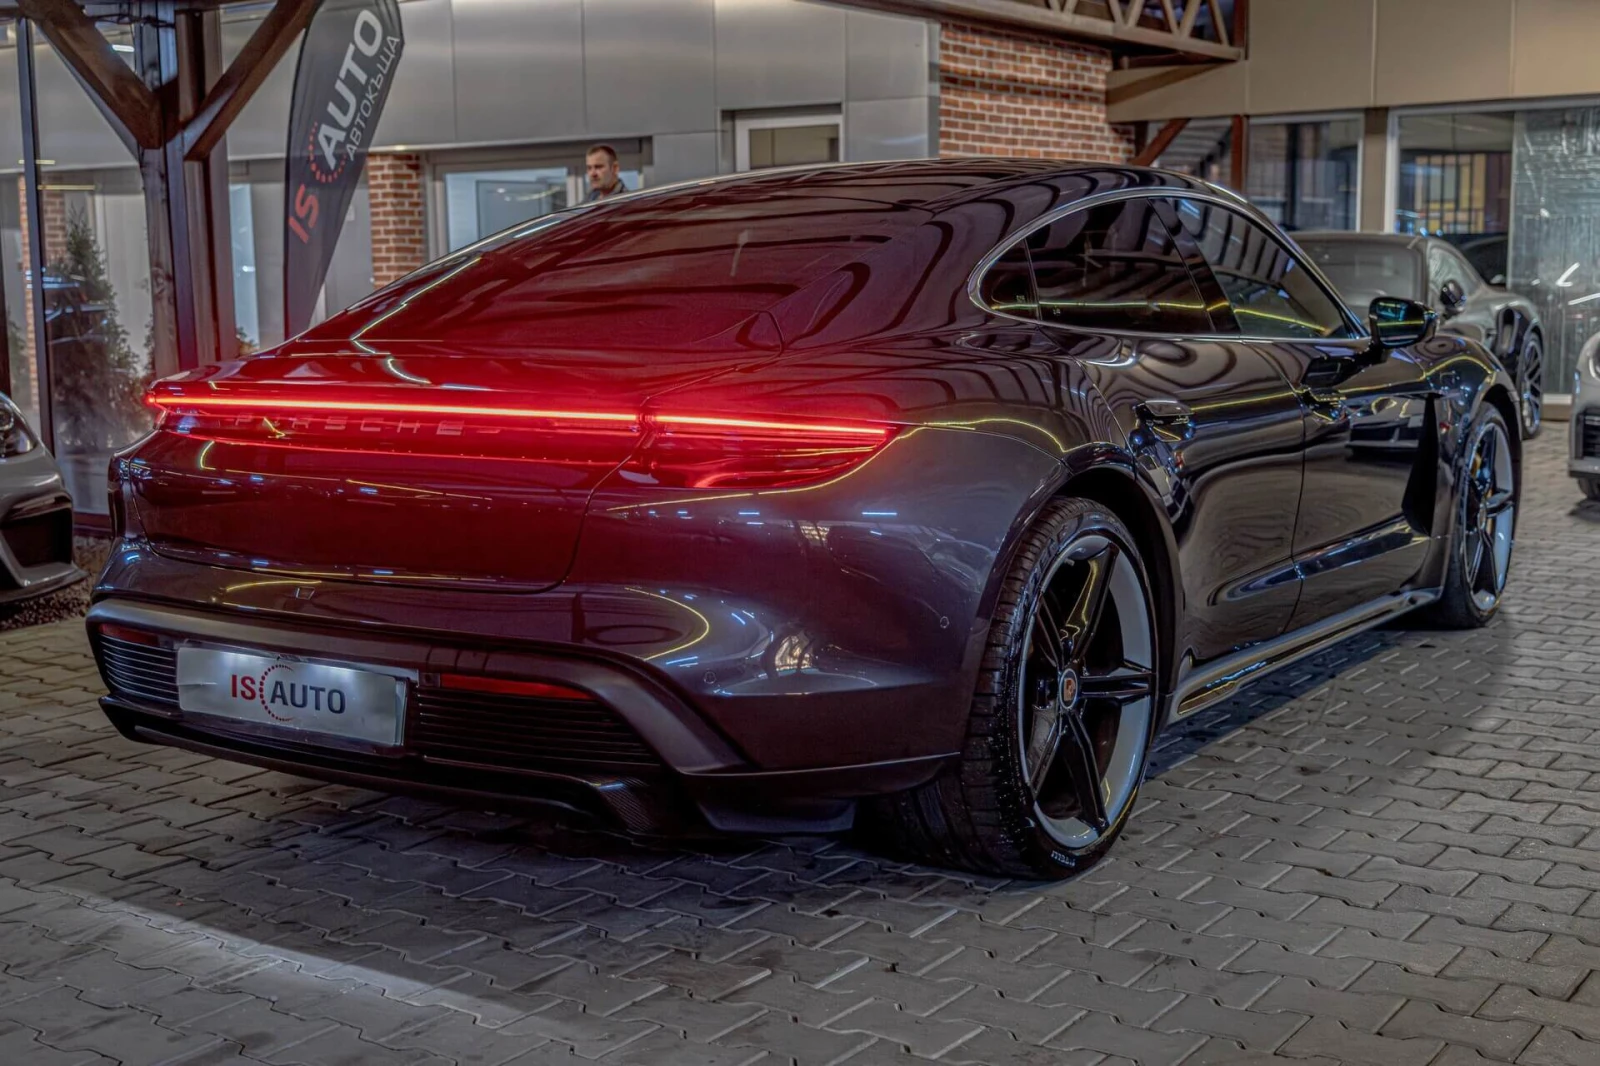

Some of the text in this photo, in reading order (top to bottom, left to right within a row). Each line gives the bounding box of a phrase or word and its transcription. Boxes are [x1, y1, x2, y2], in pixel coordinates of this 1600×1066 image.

[288, 9, 383, 244] IS AUTO
[346, 36, 400, 161] АВТОКЪЩА
[231, 674, 346, 714] IS AUTO
